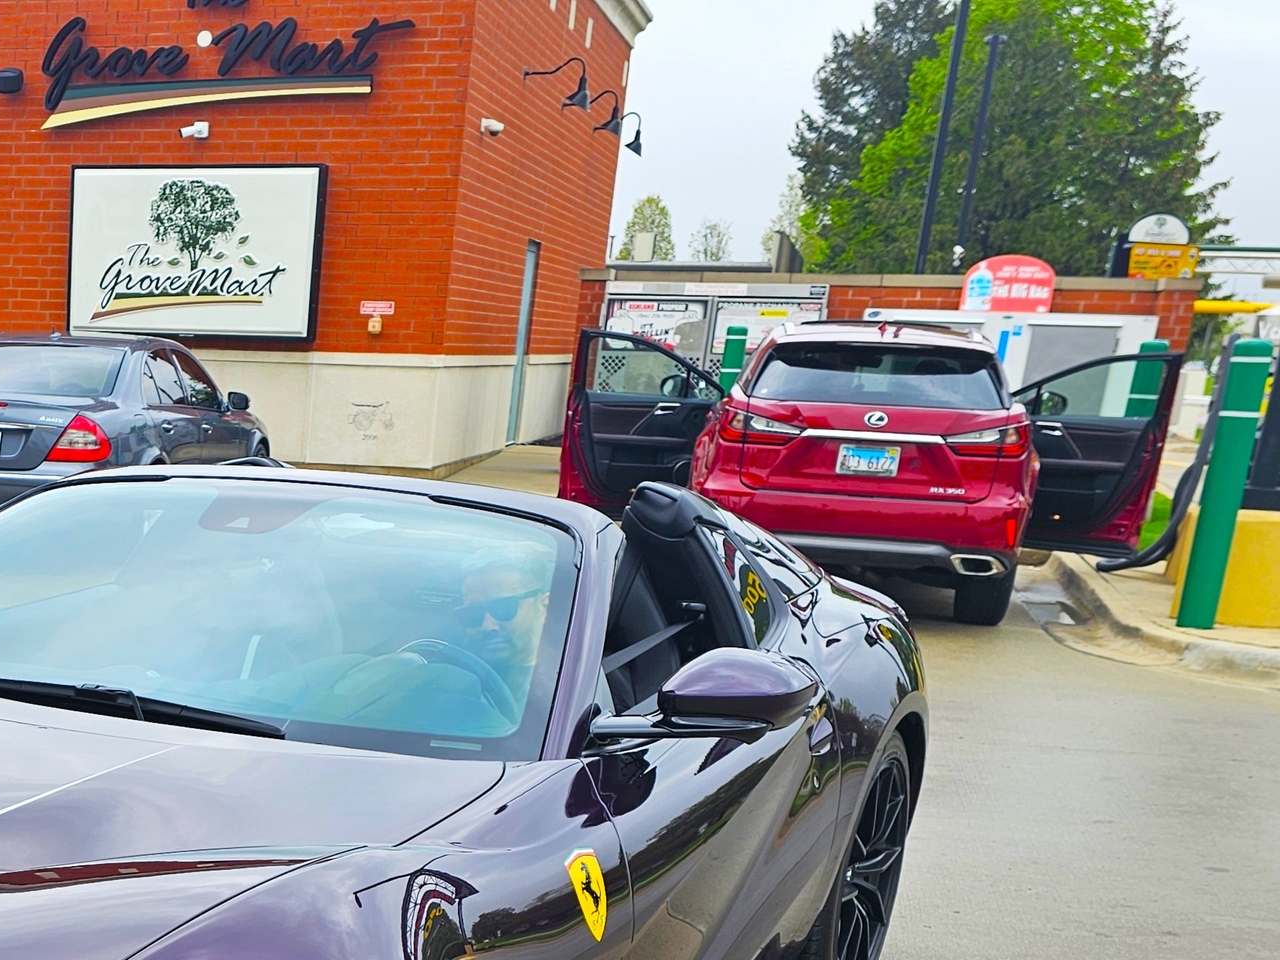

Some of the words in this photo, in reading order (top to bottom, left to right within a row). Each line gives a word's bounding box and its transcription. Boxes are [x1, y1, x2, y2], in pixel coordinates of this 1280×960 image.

[41, 16, 190, 111] Grove
[211, 17, 417, 77] Mart
[127, 243, 161, 267] The
[99, 258, 188, 310] Grove
[187, 264, 287, 295] Mart
[993, 284, 1010, 297] THE
[1010, 283, 1028, 298] BIG
[1028, 284, 1051, 299] BAG
[929, 486, 945, 494] RX
[946, 487, 966, 495] 350
